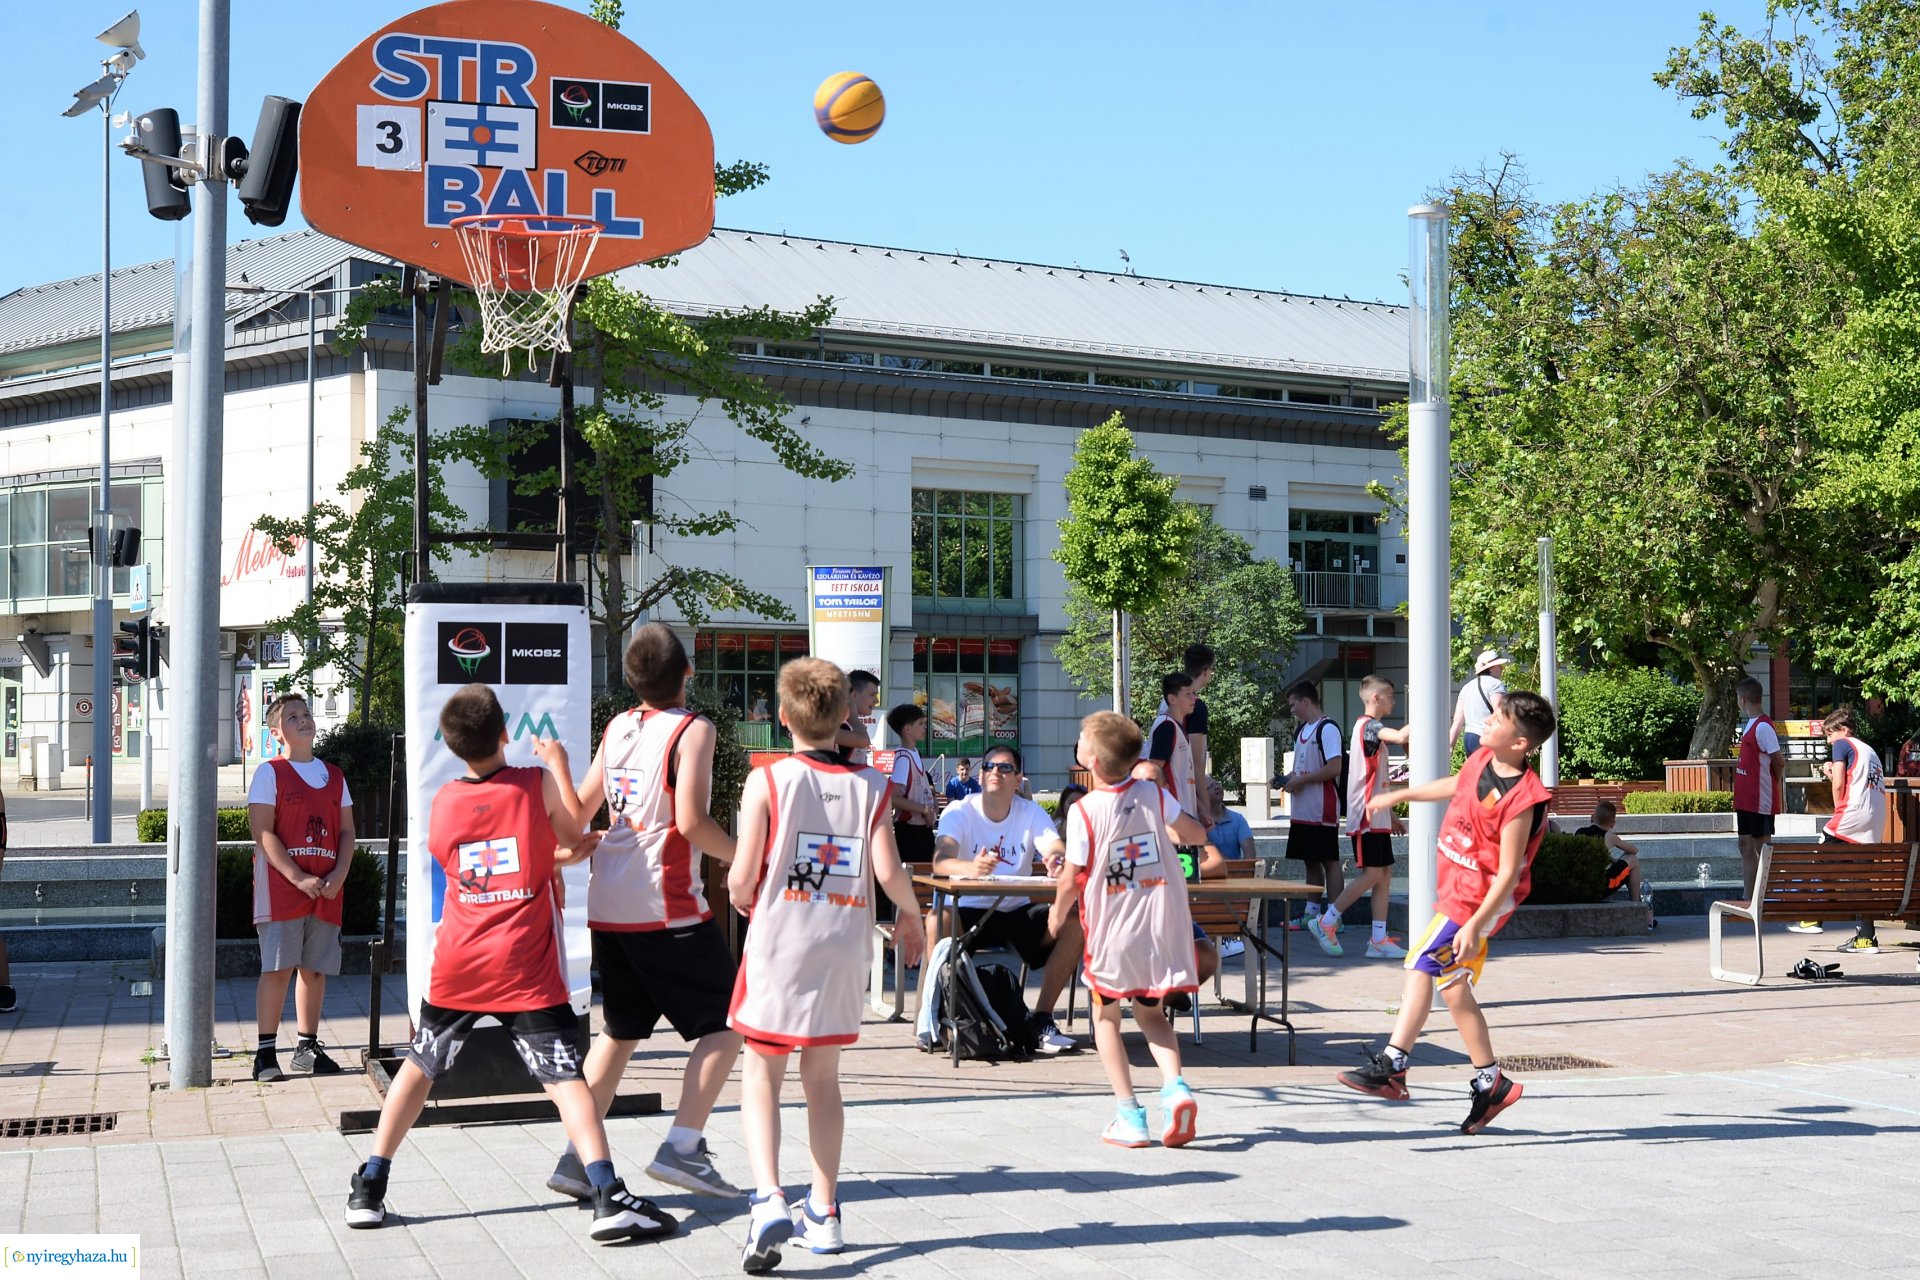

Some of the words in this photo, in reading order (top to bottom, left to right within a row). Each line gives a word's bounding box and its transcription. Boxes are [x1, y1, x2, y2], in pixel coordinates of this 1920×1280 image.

[369, 32, 538, 108] STR
[607, 102, 644, 112] MKOSZ
[375, 120, 404, 154] 3
[424, 161, 644, 240] BALL
[831, 583, 849, 592] TETT
[850, 583, 879, 592] ISKOLA
[818, 598, 842, 606] TOM
[843, 598, 878, 606] TAILOR
[511, 648, 562, 658] MKOSZ
[973, 843, 1026, 858] JDAN
